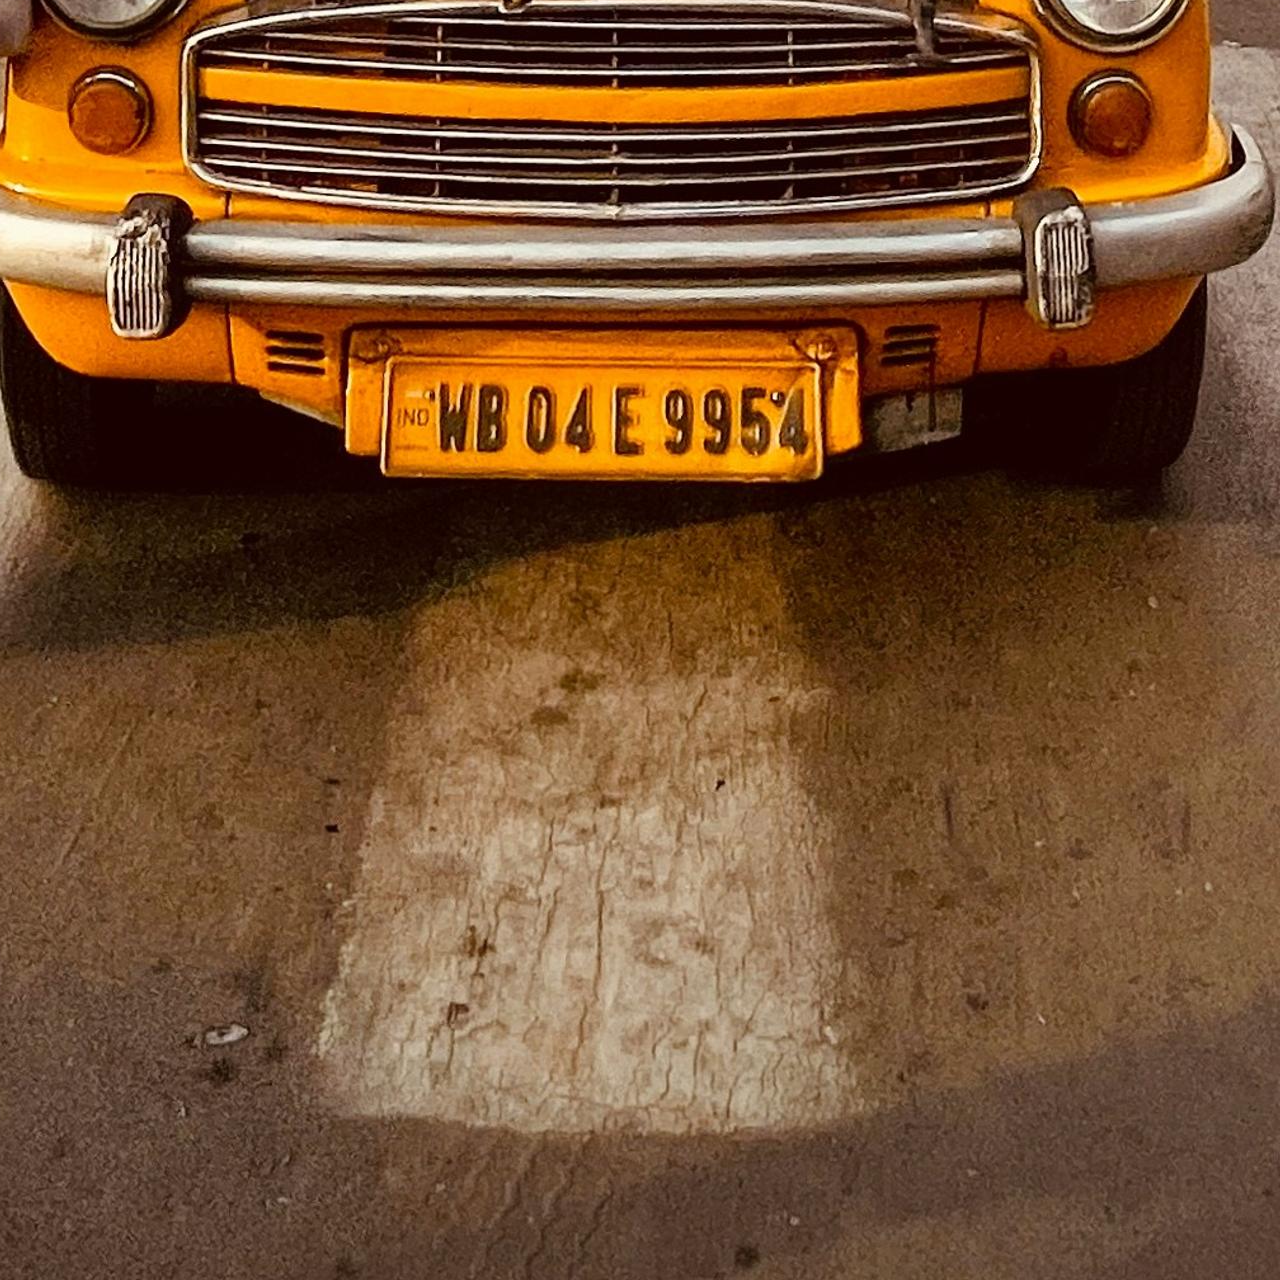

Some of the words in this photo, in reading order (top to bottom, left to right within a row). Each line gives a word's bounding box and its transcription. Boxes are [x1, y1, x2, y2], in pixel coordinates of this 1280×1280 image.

[396, 407, 430, 428] IND
[438, 381, 509, 454] WB
[525, 384, 595, 455] 04
[612, 387, 645, 456] E
[663, 387, 810, 456] 9954
